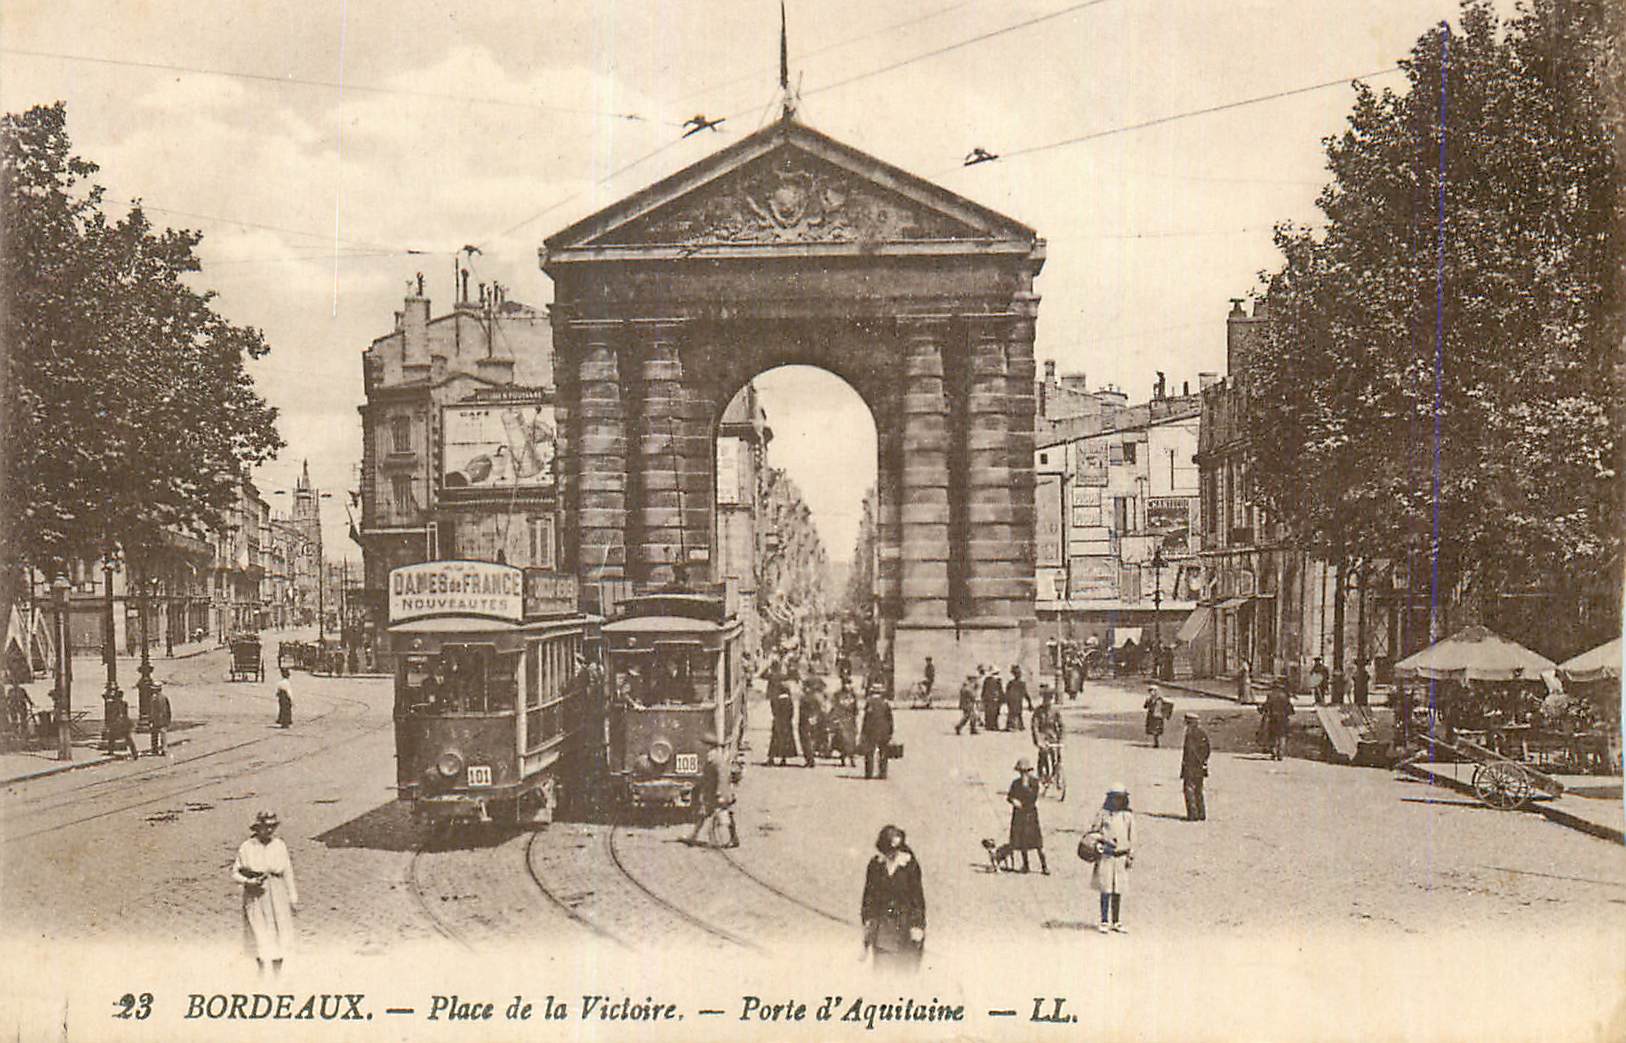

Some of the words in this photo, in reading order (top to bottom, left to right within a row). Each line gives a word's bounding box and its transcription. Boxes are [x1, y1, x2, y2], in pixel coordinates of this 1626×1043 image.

[394, 572, 448, 596] DAMES
[463, 572, 521, 597] FRANCE
[469, 768, 491, 785] 101
